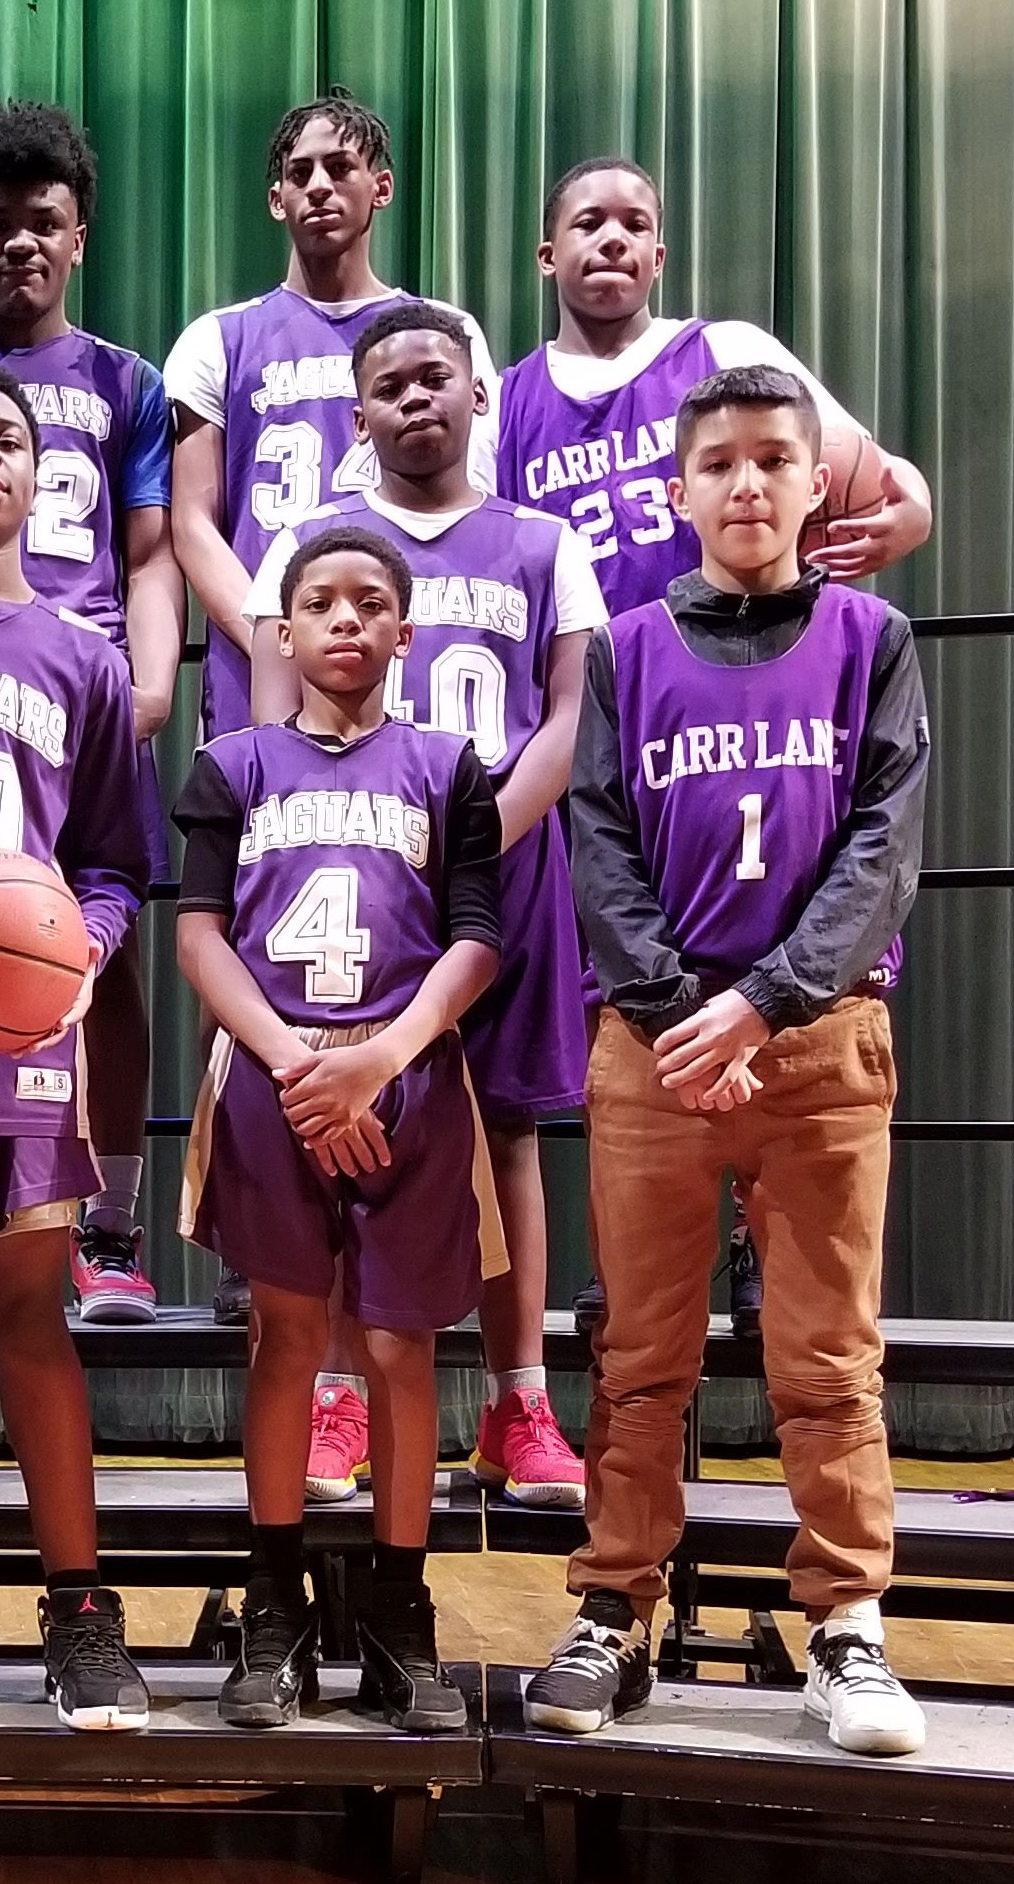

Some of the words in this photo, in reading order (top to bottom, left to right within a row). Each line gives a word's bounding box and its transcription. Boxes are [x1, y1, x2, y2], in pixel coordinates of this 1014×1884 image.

[525, 438, 611, 500] CARR
[611, 415, 677, 472] LAN
[570, 476, 676, 564] 23
[407, 576, 529, 643] UARS
[641, 723, 747, 790] CARR
[753, 718, 851, 776] LANE
[237, 790, 430, 869] JAGUARS
[736, 793, 766, 881] 1
[265, 867, 371, 1004] 4
